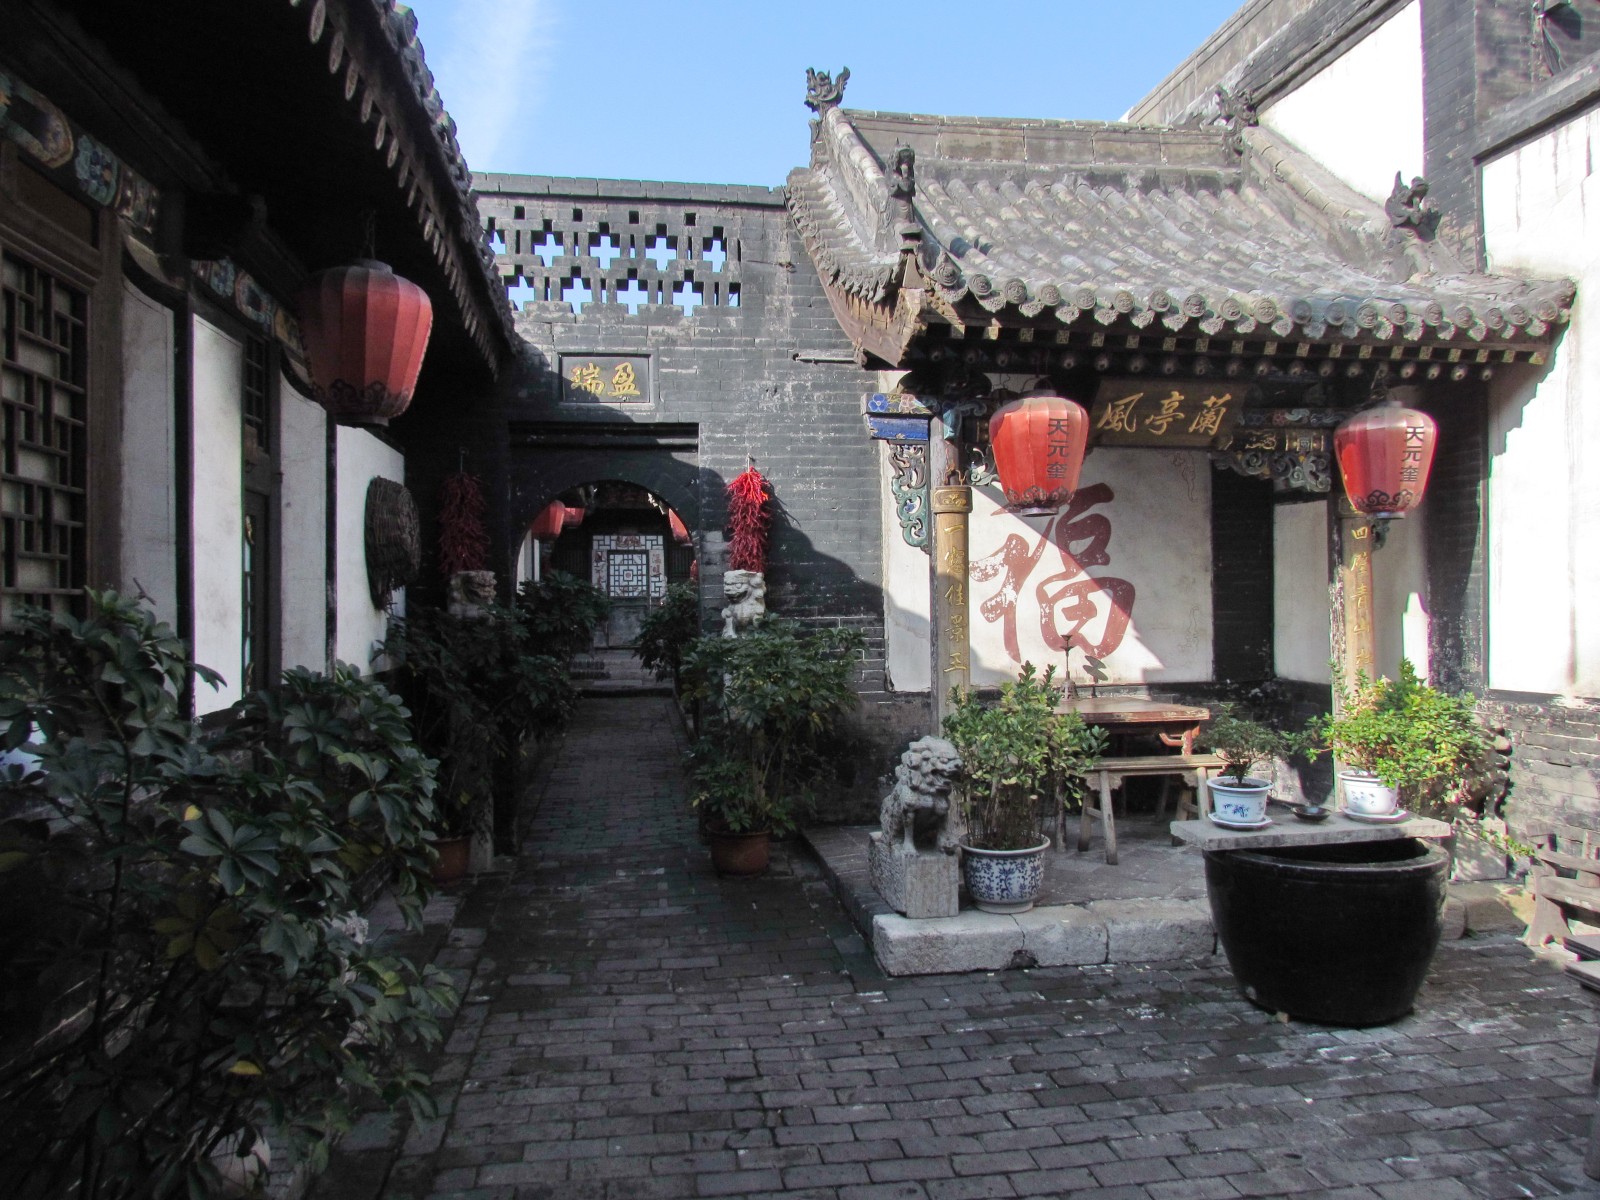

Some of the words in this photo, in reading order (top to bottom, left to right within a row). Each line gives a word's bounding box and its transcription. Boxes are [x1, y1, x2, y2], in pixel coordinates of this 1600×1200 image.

[1046, 416, 1070, 481] 天元奎
[1399, 425, 1425, 483] 天元奎
[969, 482, 1136, 663] 福
